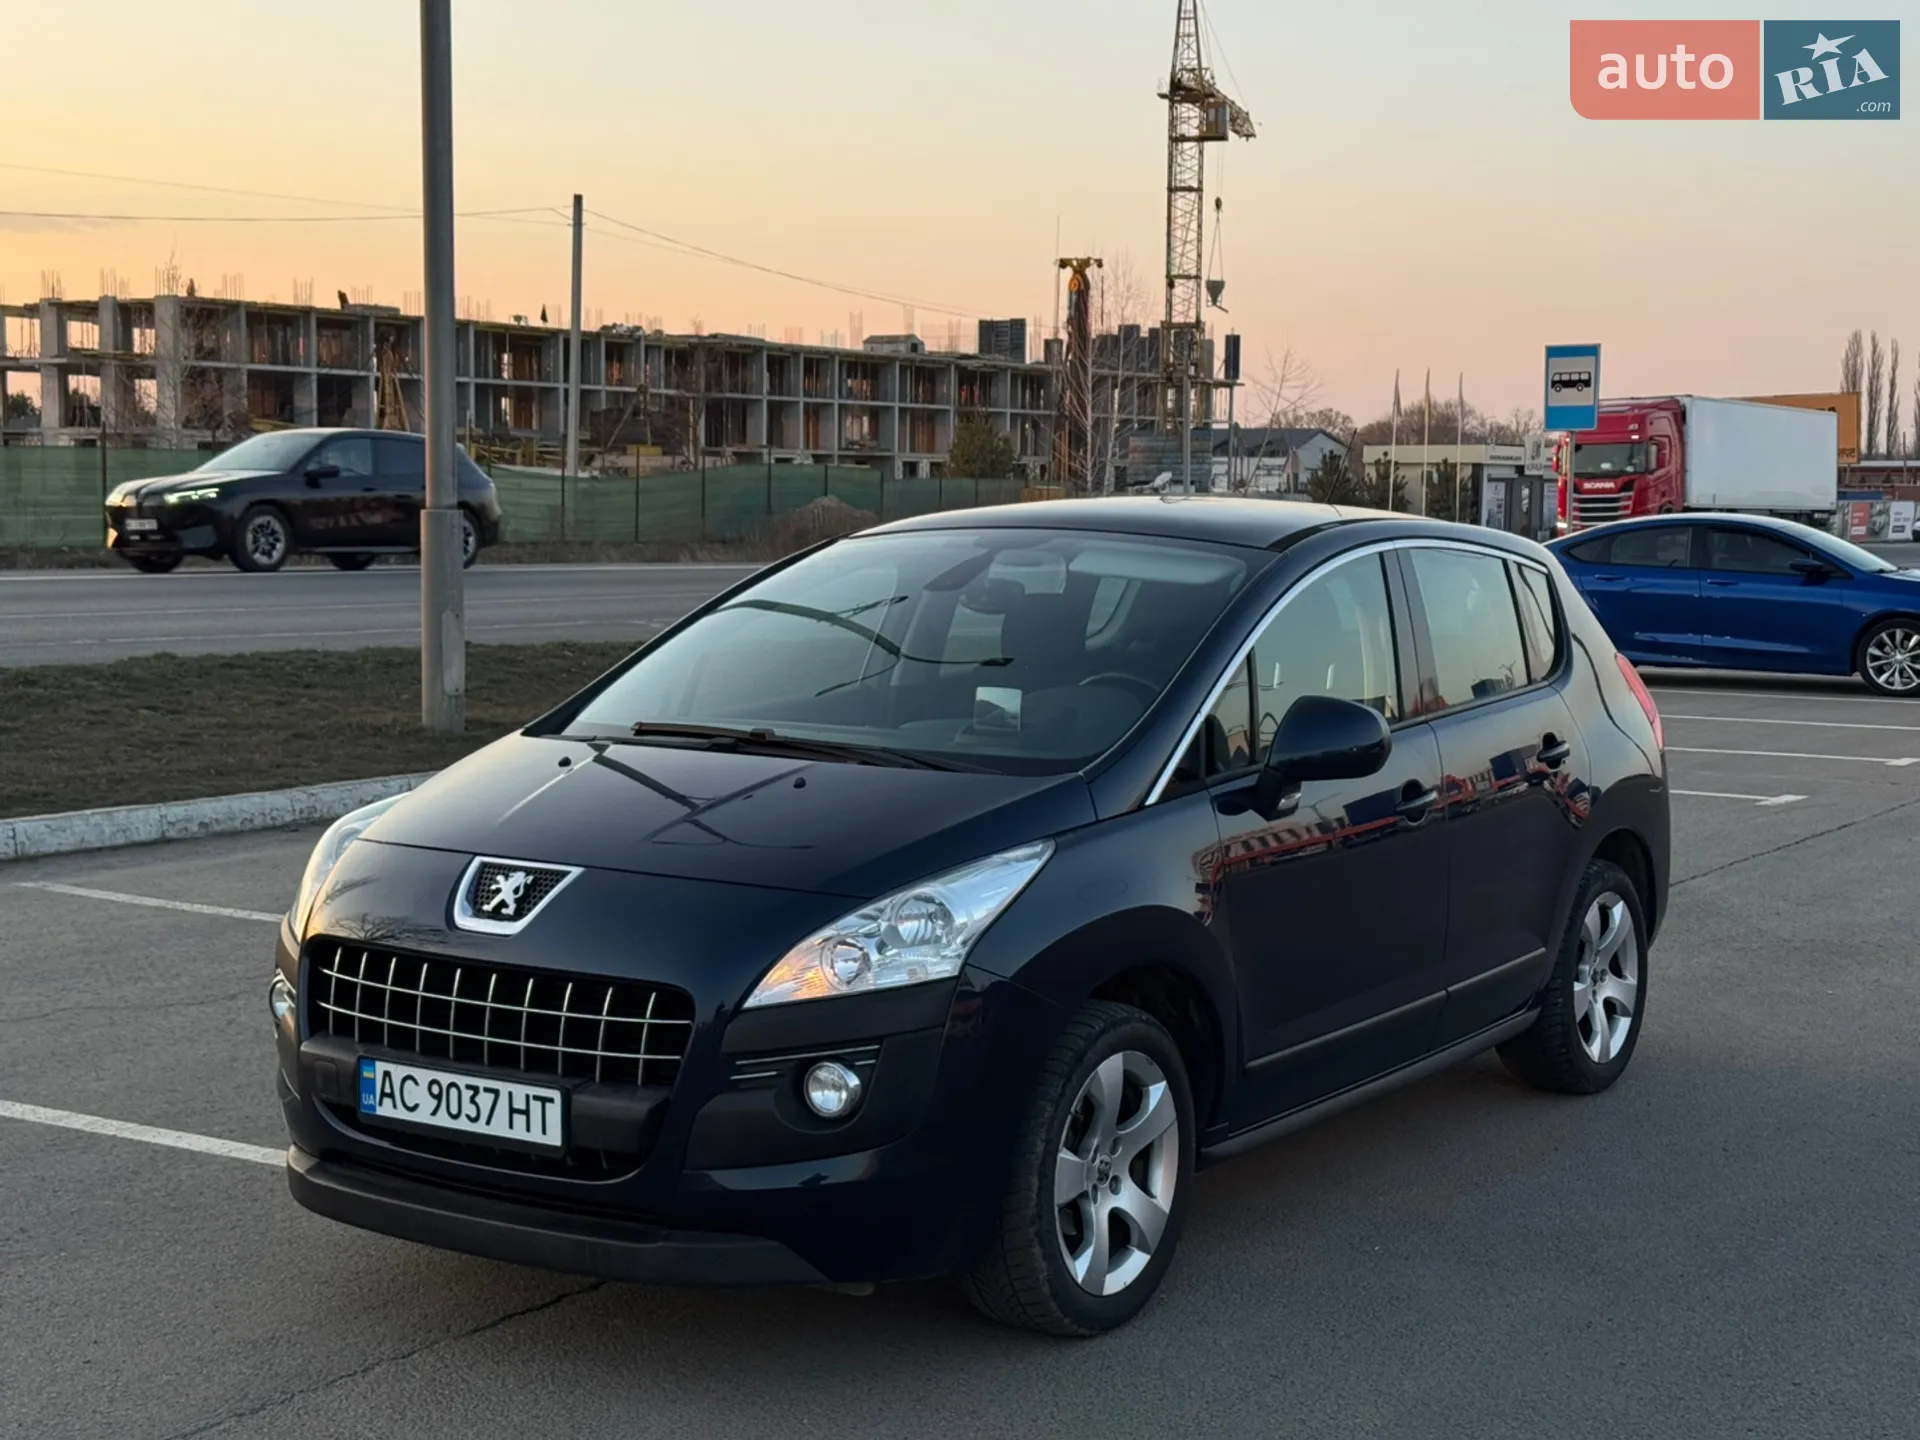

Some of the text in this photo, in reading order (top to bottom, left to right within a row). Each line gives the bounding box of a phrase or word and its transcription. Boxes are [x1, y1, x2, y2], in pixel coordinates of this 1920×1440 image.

[362, 1093, 375, 1106] UA
[378, 1070, 555, 1136] AC 9037 HT
